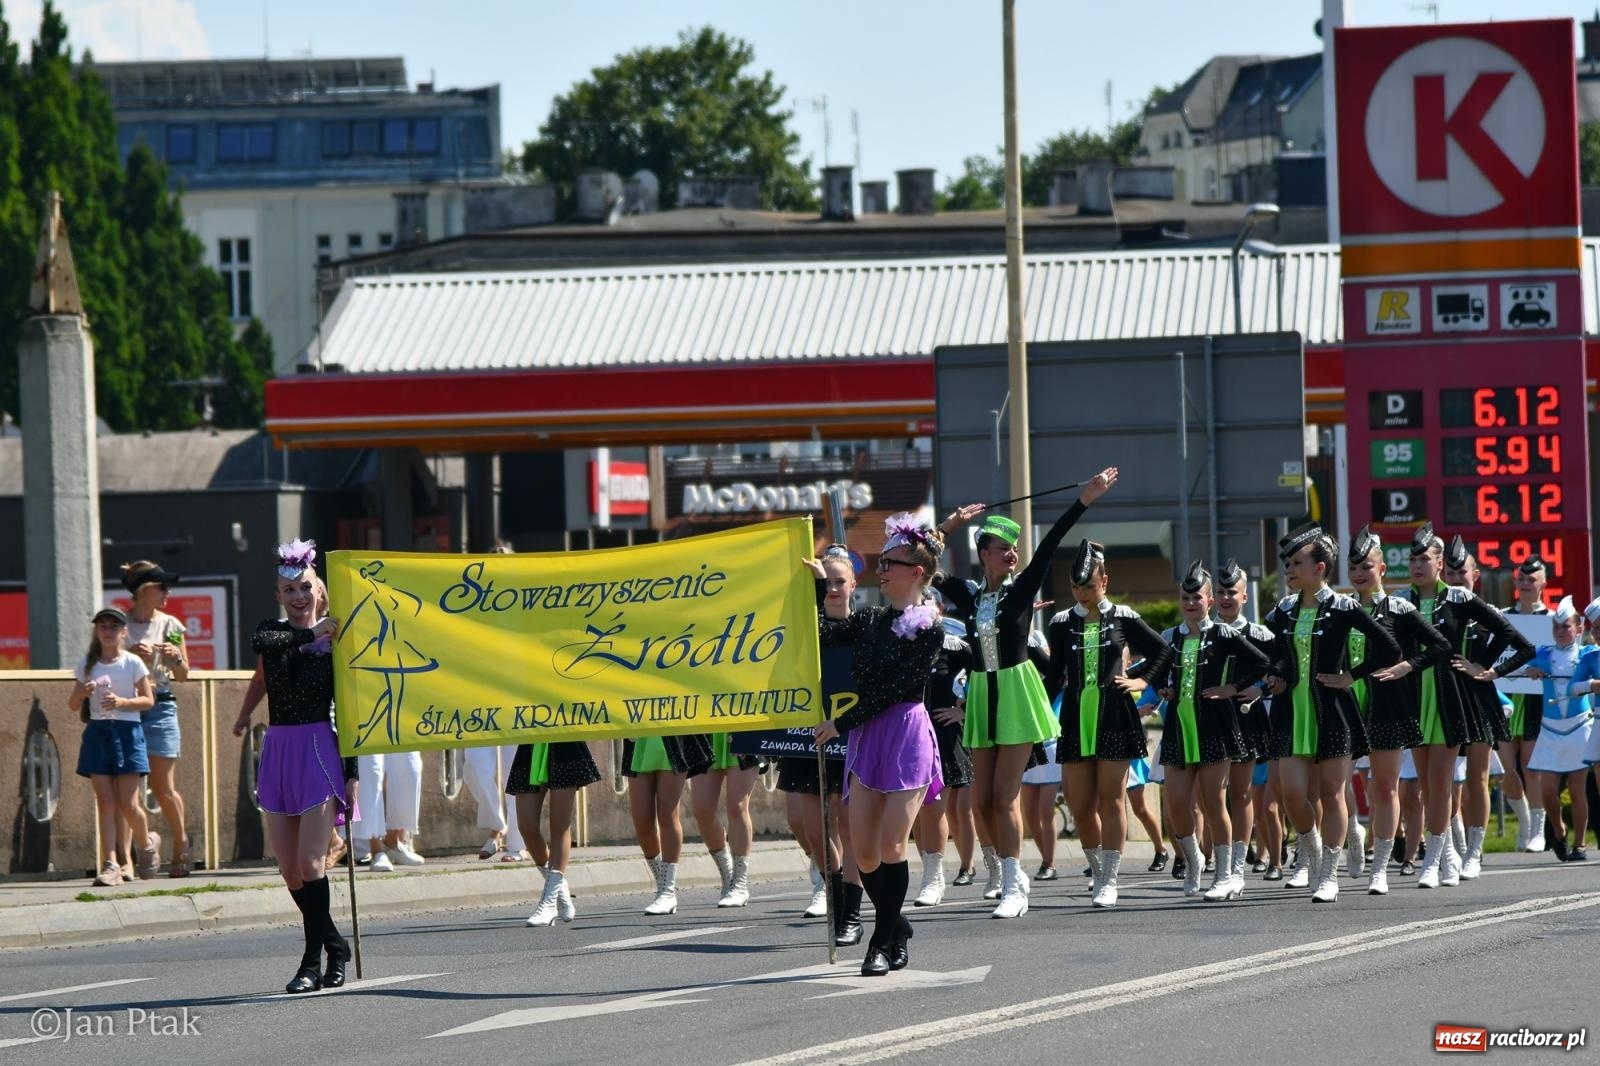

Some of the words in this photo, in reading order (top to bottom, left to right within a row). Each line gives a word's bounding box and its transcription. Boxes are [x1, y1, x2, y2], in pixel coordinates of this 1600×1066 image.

[1412, 71, 1521, 205] K
[1377, 290, 1411, 320] R
[1387, 395, 1405, 414] D
[1474, 386, 1559, 427] 6.12
[1383, 443, 1412, 462] 95
[1476, 435, 1561, 476] 5.94
[1390, 492, 1408, 511] D
[1477, 484, 1561, 524] 6.12
[1386, 547, 1411, 567] 95
[439, 560, 727, 618] Stowarzyszenie
[553, 611, 787, 680] Źródło
[416, 705, 503, 740] ŚLĄSK
[514, 700, 611, 729] KRAINA
[622, 694, 699, 724] WIELU
[710, 687, 813, 719] KULTUR
[760, 740, 806, 752] ZAWADA
